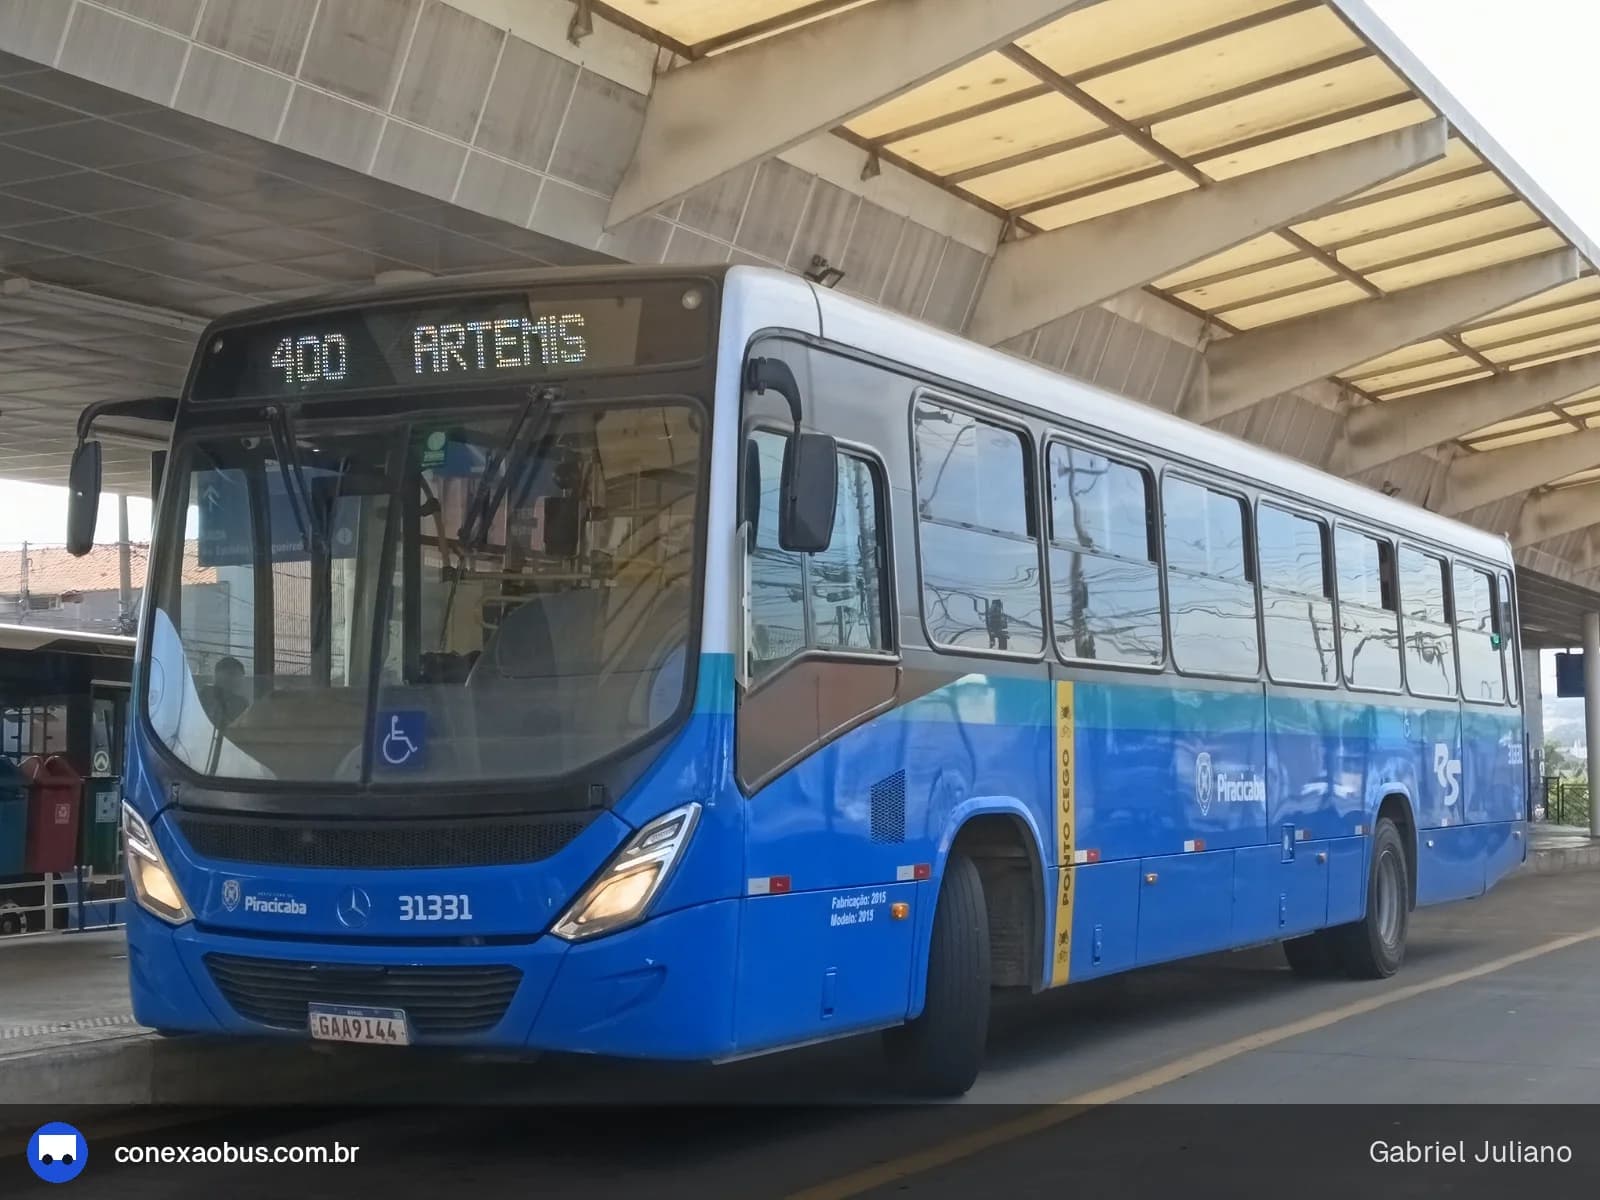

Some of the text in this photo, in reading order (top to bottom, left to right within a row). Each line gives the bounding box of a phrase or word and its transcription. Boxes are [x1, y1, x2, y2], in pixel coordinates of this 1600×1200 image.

[271, 313, 586, 383] 400 ARTEMIS
[1217, 773, 1266, 803] Piracicaba
[1062, 749, 1071, 906] PONTO CEGO
[245, 895, 307, 915] Piracicaba
[399, 894, 472, 921] 31331
[831, 891, 887, 909] Fabricação: 2015
[830, 911, 857, 927] Modelo:
[319, 1016, 397, 1041] GAA9I44
